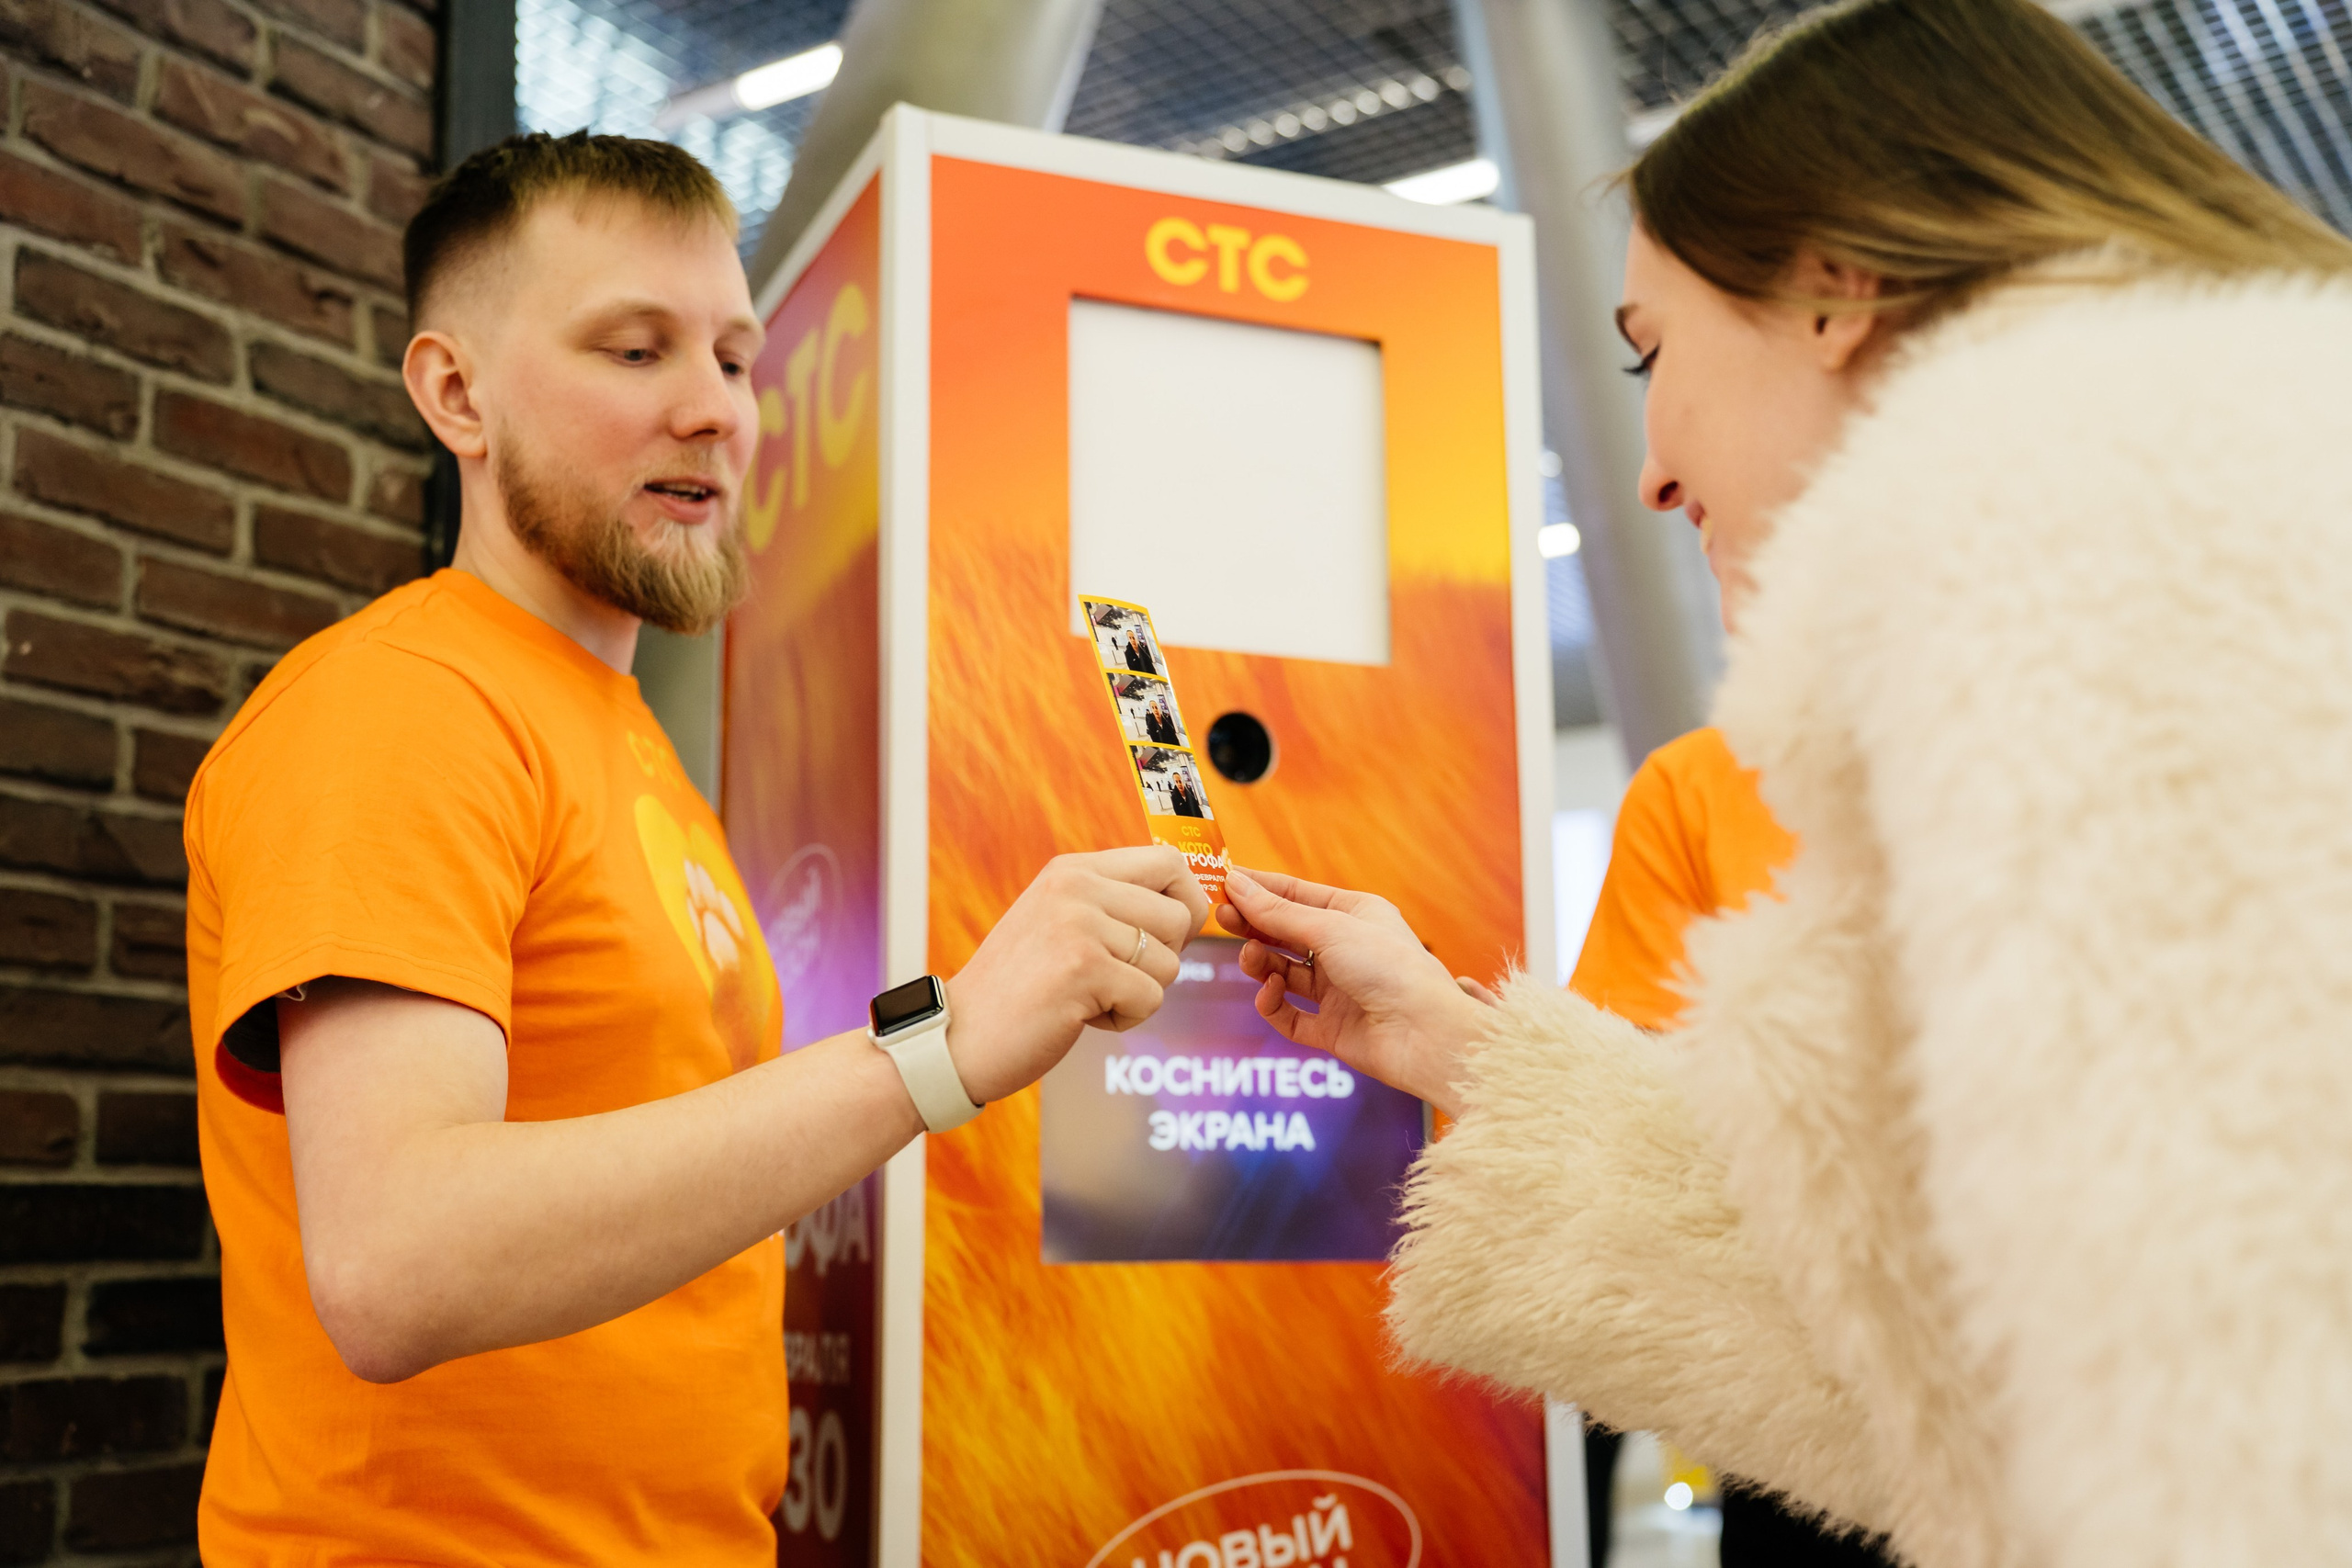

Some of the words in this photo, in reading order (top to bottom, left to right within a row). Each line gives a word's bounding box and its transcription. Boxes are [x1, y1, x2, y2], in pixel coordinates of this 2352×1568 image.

[1146, 217, 1309, 302] СТС
[1178, 840, 1213, 855] КОТО
[1181, 826, 1201, 837] СТС
[1104, 1055, 1355, 1099] КОСНИТЕСЬ
[1148, 1110, 1317, 1152] ЭКРАНА
